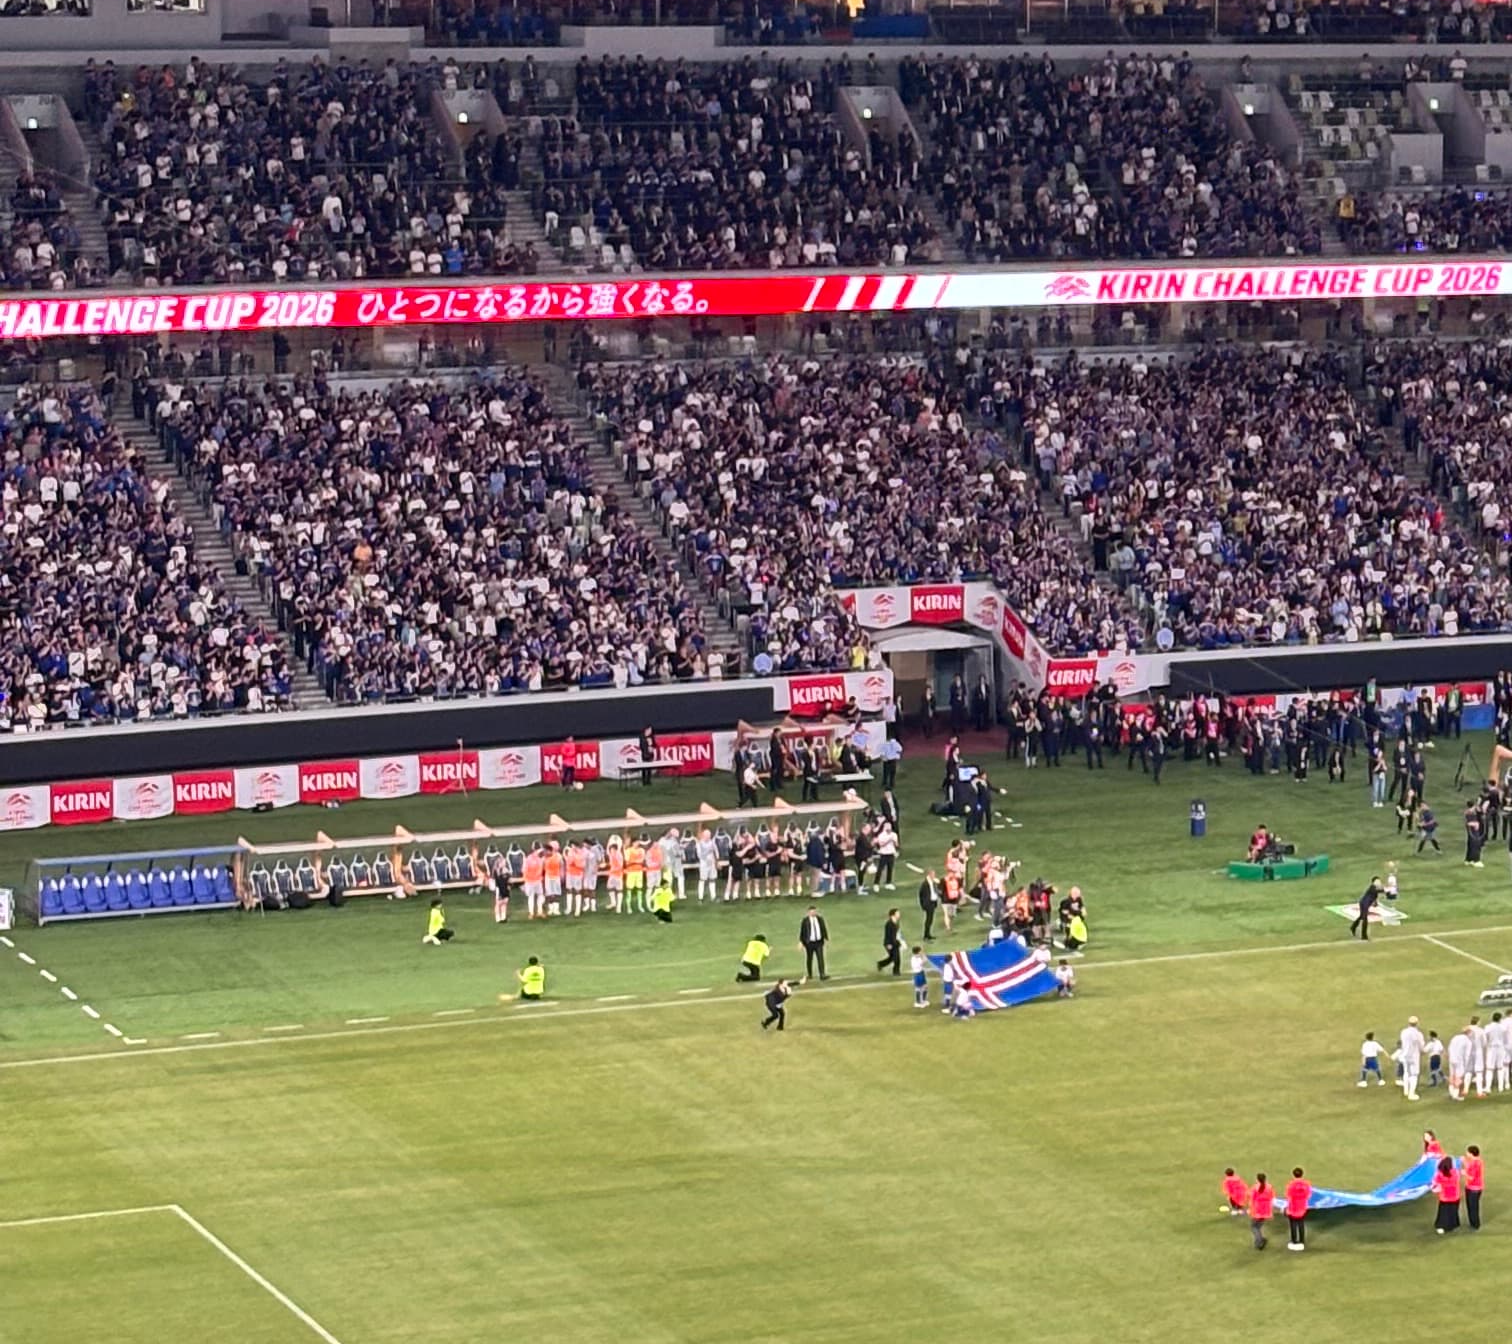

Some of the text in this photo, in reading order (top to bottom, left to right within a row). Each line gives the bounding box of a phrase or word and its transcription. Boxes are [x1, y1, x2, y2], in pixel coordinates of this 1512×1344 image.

[1095, 266, 1501, 299] KIRIN CHALLENGE CUP 2026
[356, 281, 710, 323] ひとつになるから強くなる。
[0, 291, 337, 336] HALLENGE CUP 2026
[913, 594, 962, 612] KIRIN
[1048, 668, 1094, 686] KIRIN
[792, 684, 844, 705] KIRIN
[543, 752, 597, 771] KIIN
[658, 743, 711, 763] KIRIN
[302, 771, 358, 792] KIRIN
[422, 762, 478, 782] KIRIN
[53, 791, 111, 813] KIRIN
[176, 781, 232, 802] KIRIN
